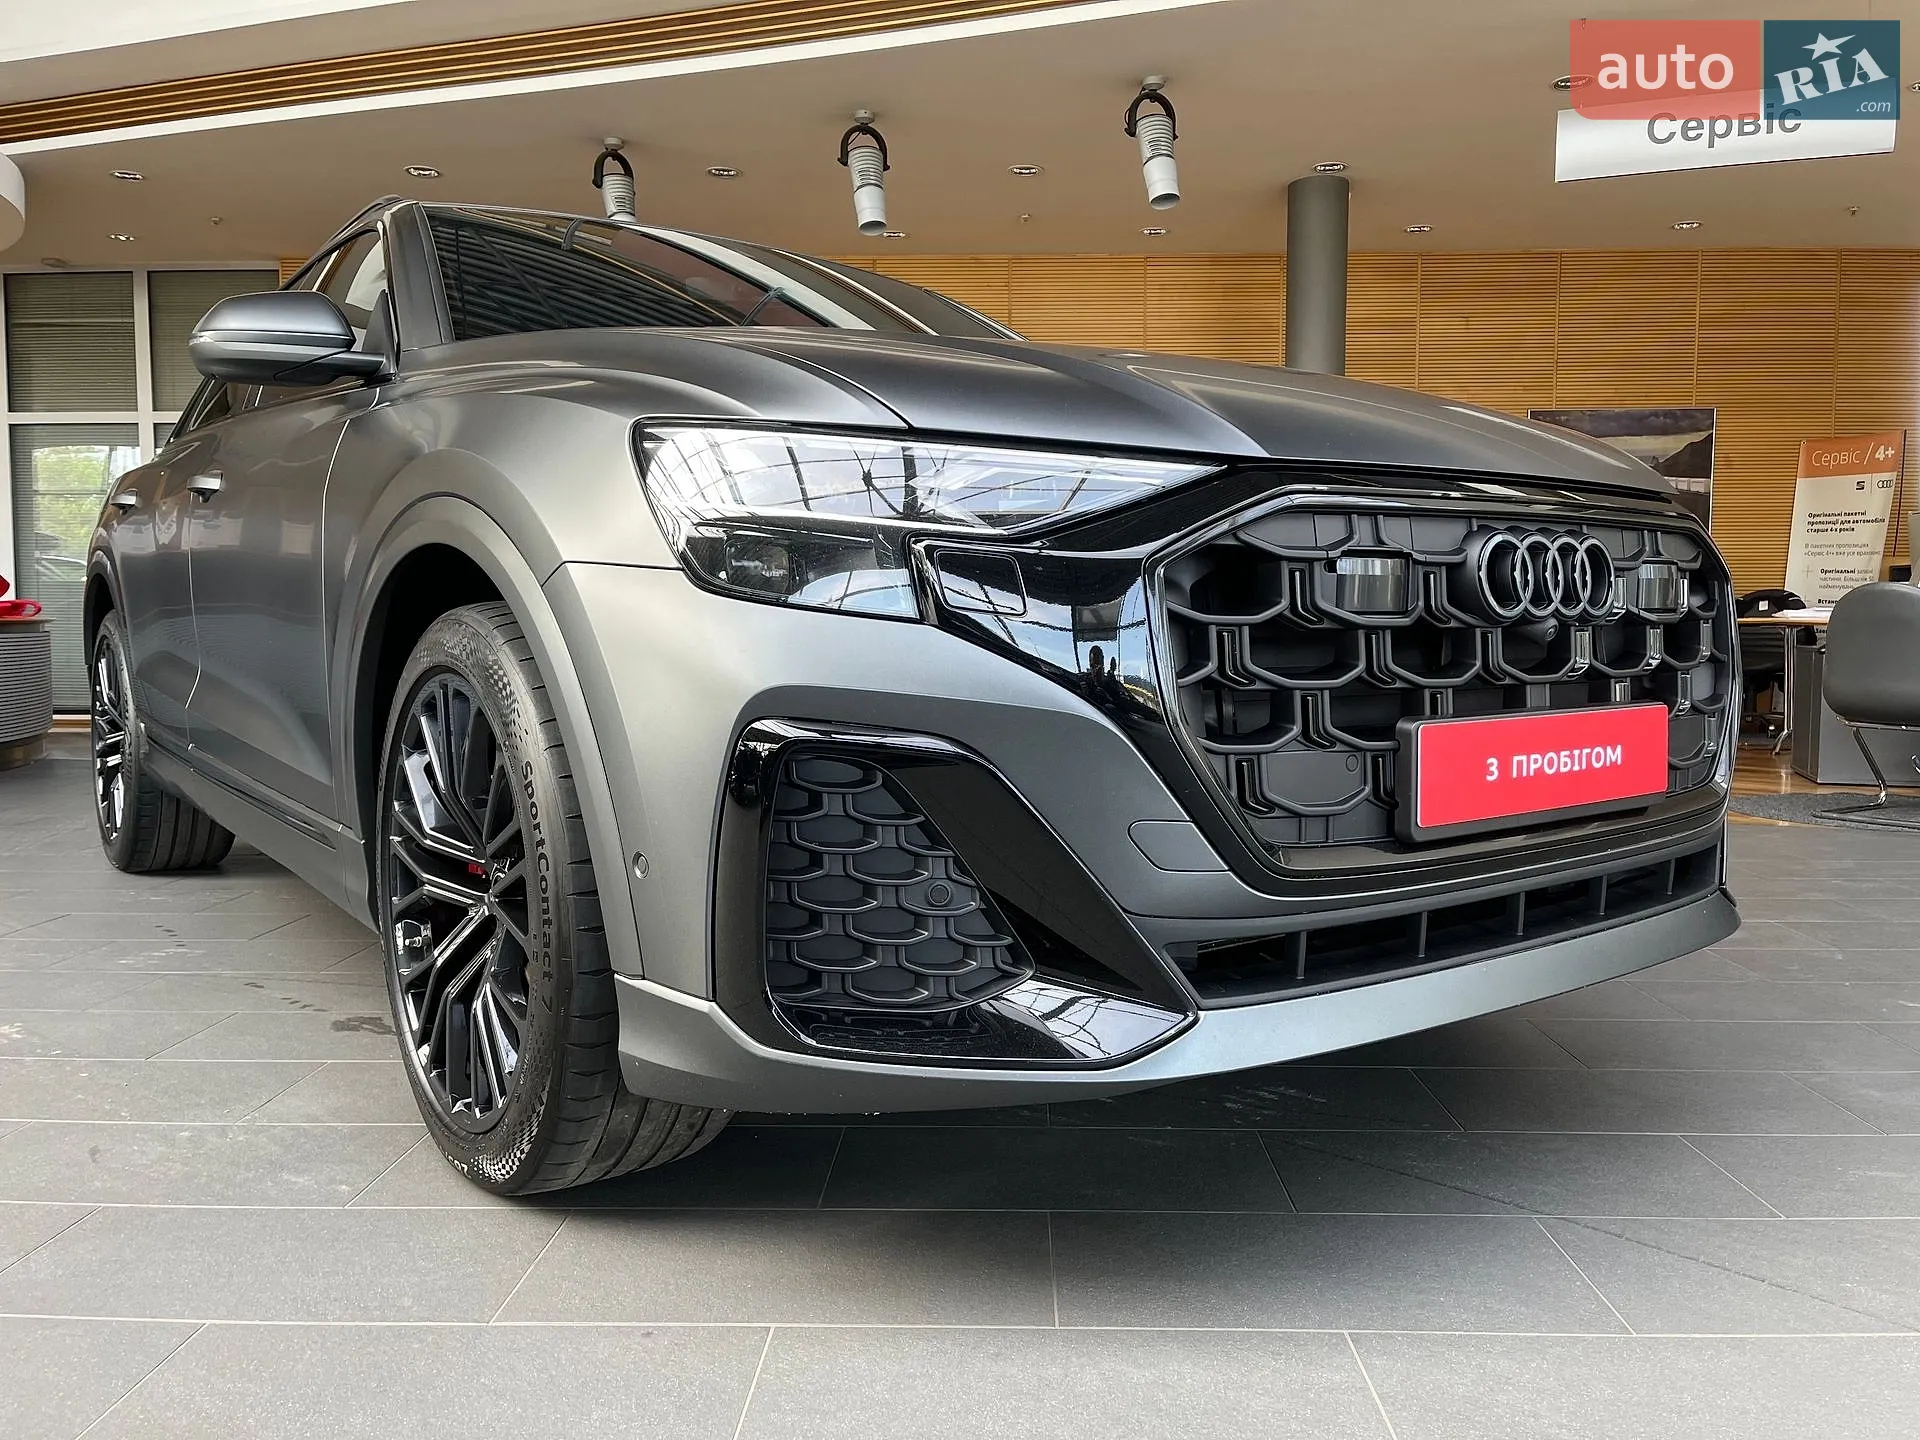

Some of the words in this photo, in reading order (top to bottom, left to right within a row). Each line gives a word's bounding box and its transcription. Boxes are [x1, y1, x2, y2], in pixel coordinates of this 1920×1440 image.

[1648, 103, 1802, 148] Сервіс
[1812, 449, 1861, 469] Сервіс
[1875, 445, 1895, 461] 4+
[1807, 519, 1840, 527] пропозиції
[1808, 511, 1843, 519] Оригінальні
[1838, 526, 1855, 534] років
[1511, 745, 1622, 778] ПРОБІГОМ
[521, 760, 551, 982] SportContact
